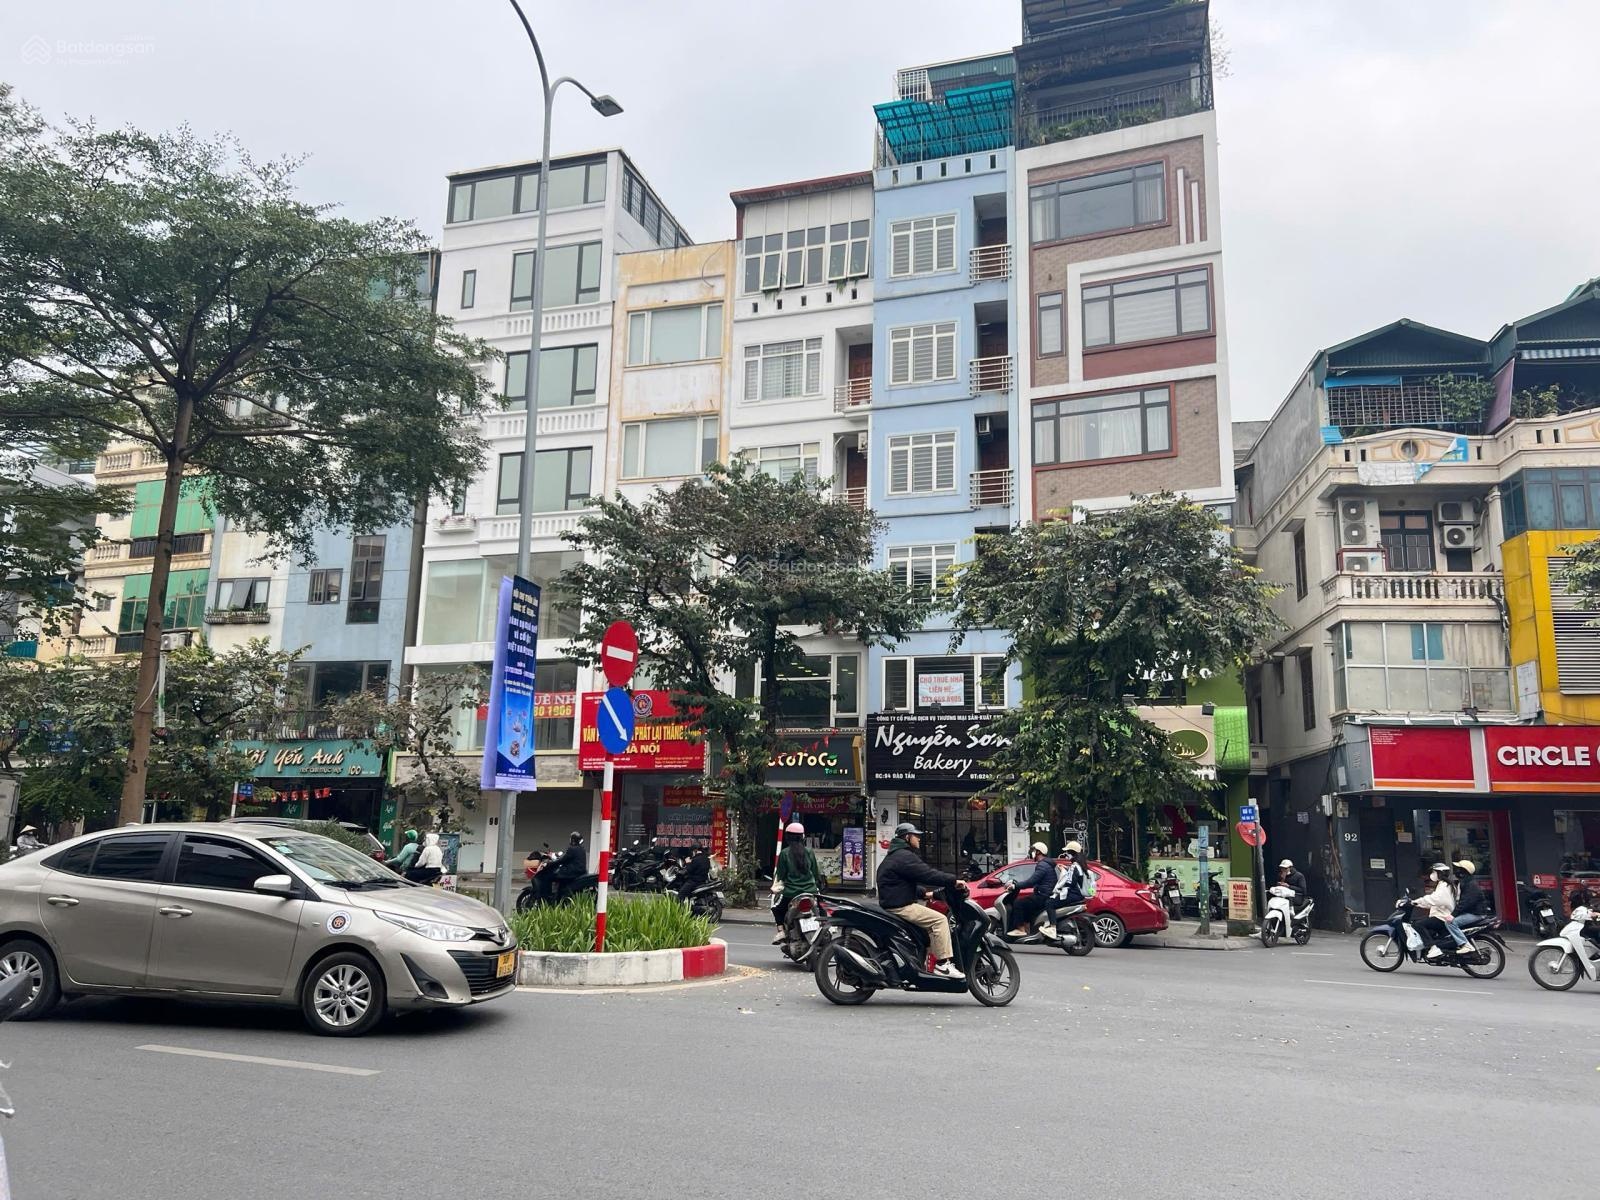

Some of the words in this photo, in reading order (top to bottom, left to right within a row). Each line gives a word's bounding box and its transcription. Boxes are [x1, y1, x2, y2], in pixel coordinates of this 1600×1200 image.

[582, 725, 596, 742] VĂN
[634, 724, 652, 741] PHÁT
[652, 726, 662, 743] LẠI
[874, 724, 961, 755] Nguyễn
[966, 723, 1013, 749] Sơn
[640, 742, 660, 755] NỘI
[1497, 746, 1590, 766] CIRCLE
[273, 746, 304, 772] Yến
[308, 748, 344, 765] Anh
[913, 753, 973, 778] Bakery
[348, 765, 361, 775] 100
[1344, 832, 1358, 842] 92
